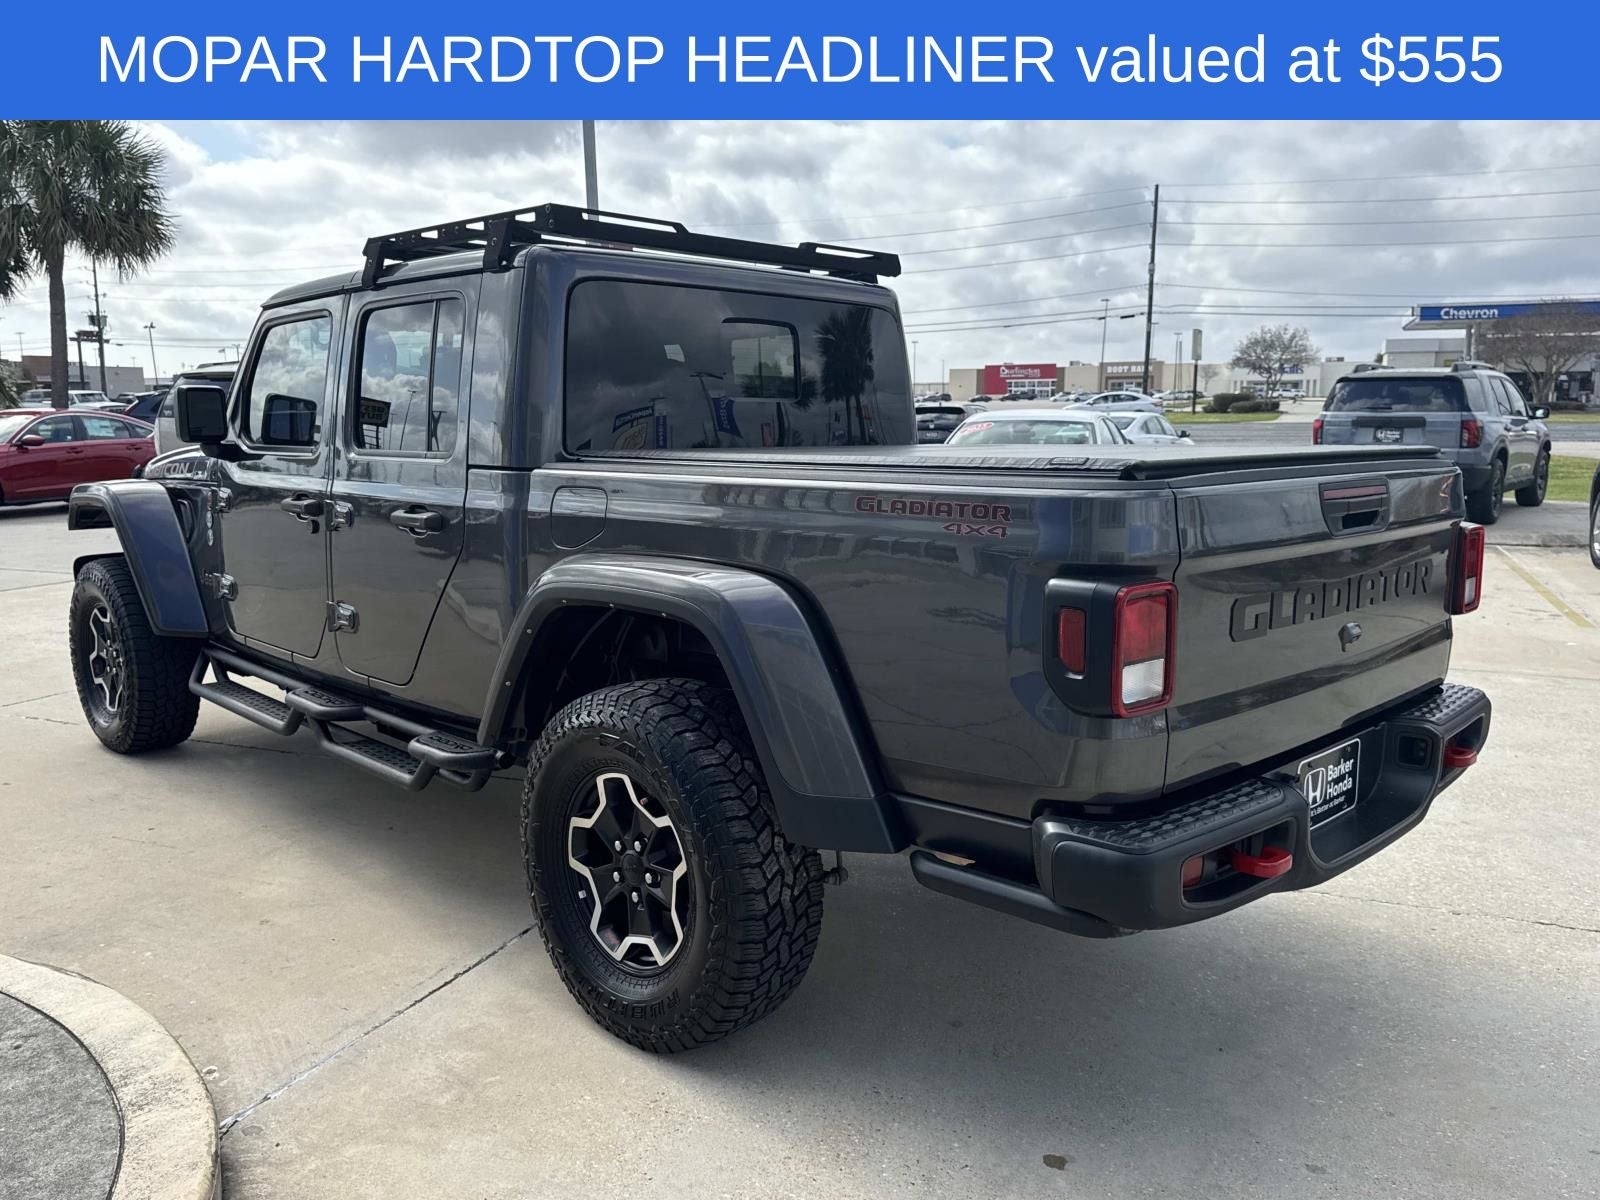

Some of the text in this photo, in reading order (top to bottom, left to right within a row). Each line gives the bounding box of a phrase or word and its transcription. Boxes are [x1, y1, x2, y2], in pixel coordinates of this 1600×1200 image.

[1440, 308, 1498, 320] Chevron
[855, 495, 1013, 522] GLADIATOR
[1229, 558, 1433, 642] GLADIATOR
[1327, 758, 1354, 782] Barker
[1326, 774, 1353, 800] Honda
